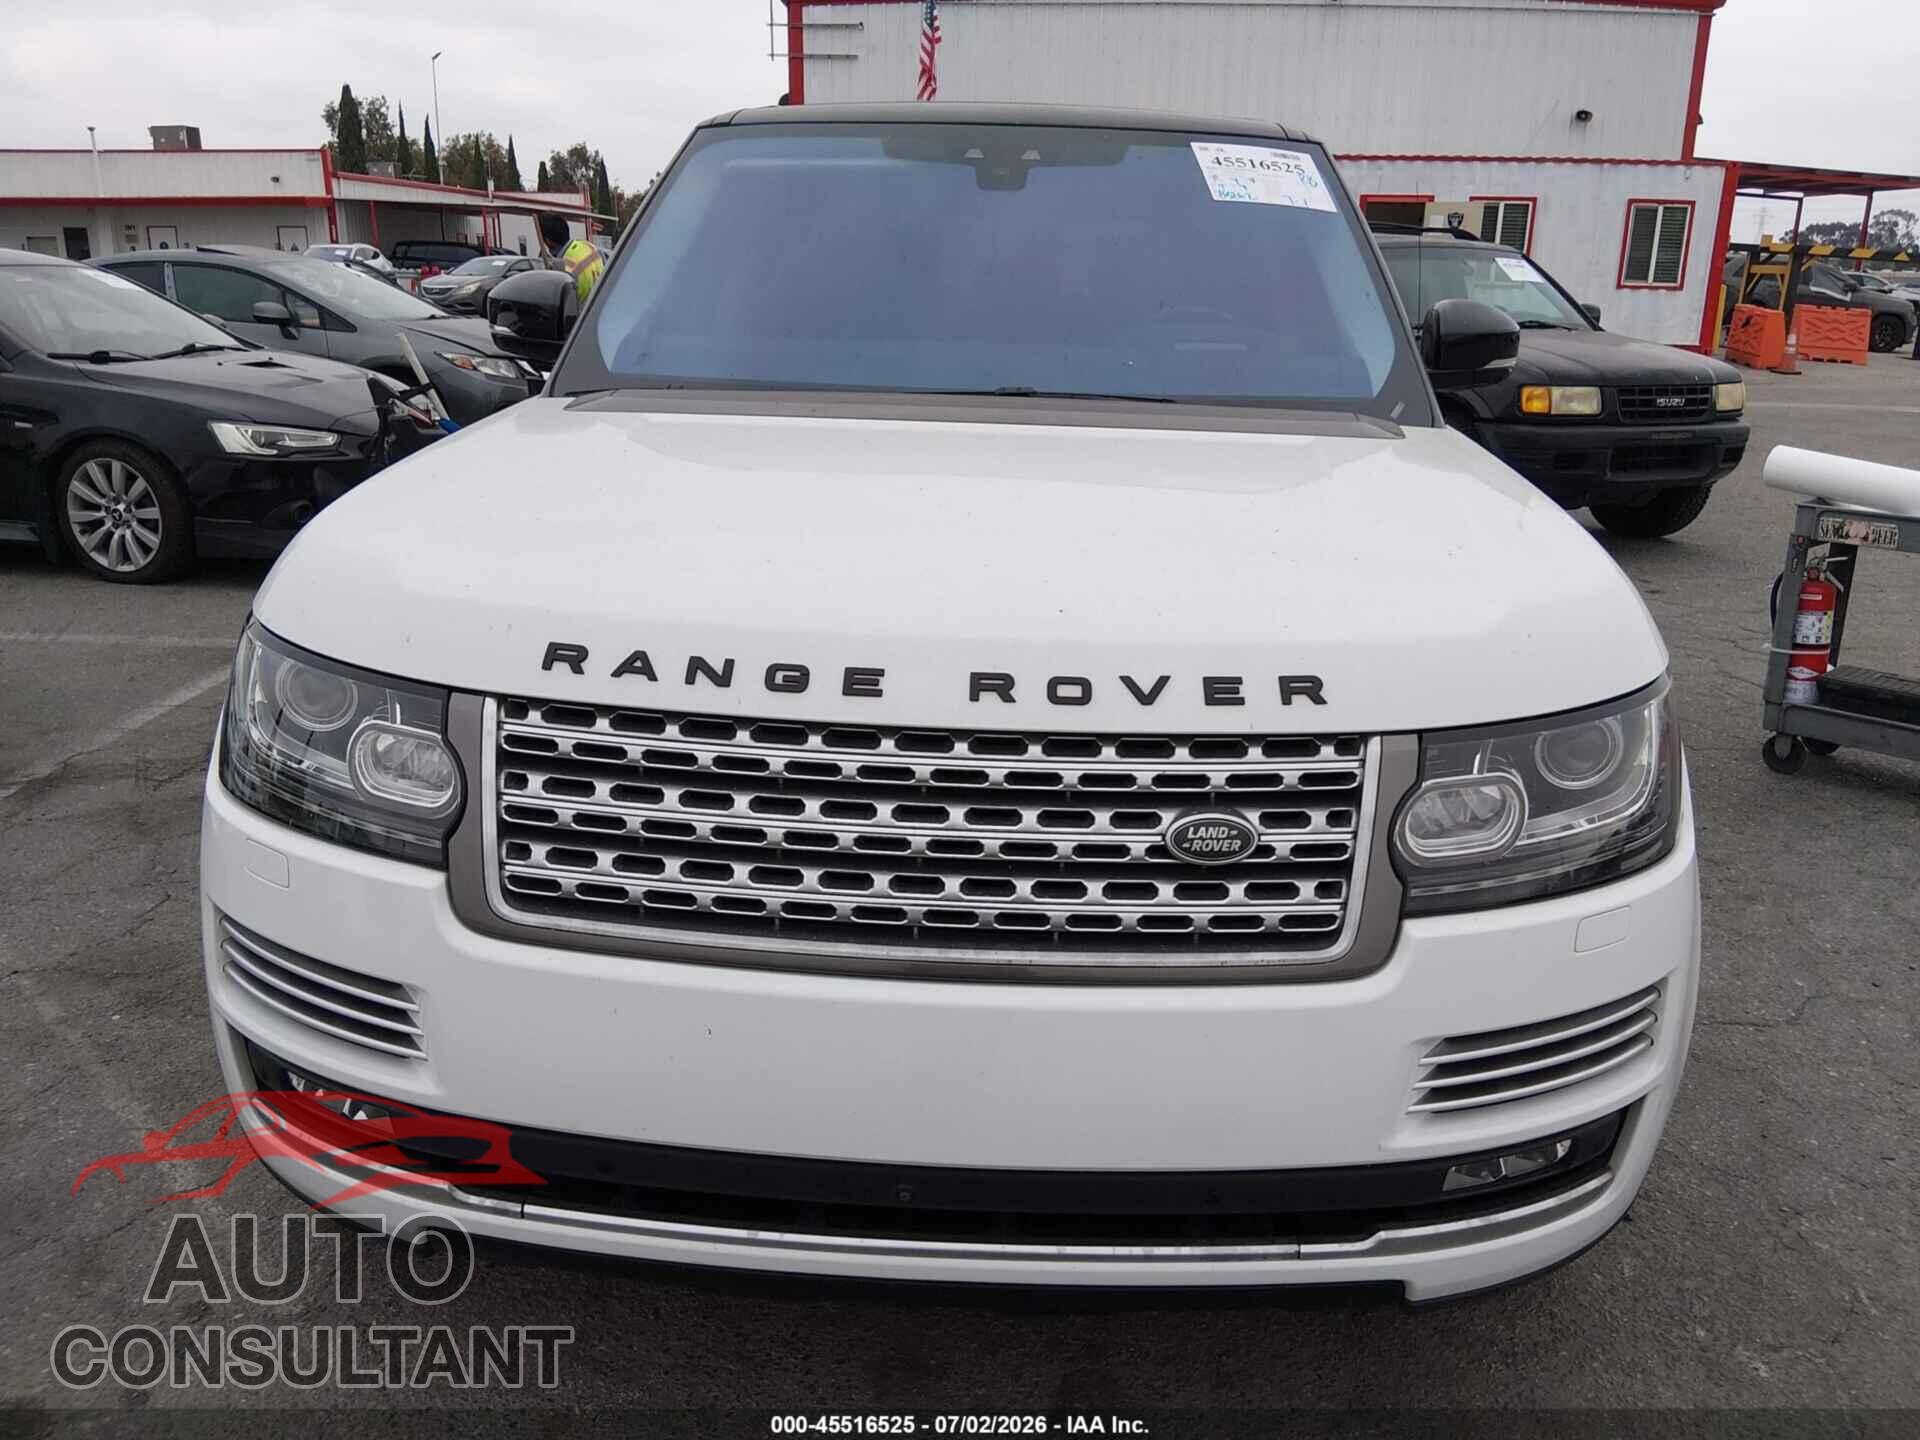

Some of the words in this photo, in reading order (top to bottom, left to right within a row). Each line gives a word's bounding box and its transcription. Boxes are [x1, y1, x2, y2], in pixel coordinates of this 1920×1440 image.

[1211, 155, 1306, 176] 45516525
[1656, 398, 1686, 407] ISUZU
[541, 641, 886, 698] RANGE
[969, 671, 1329, 706] ROVER
